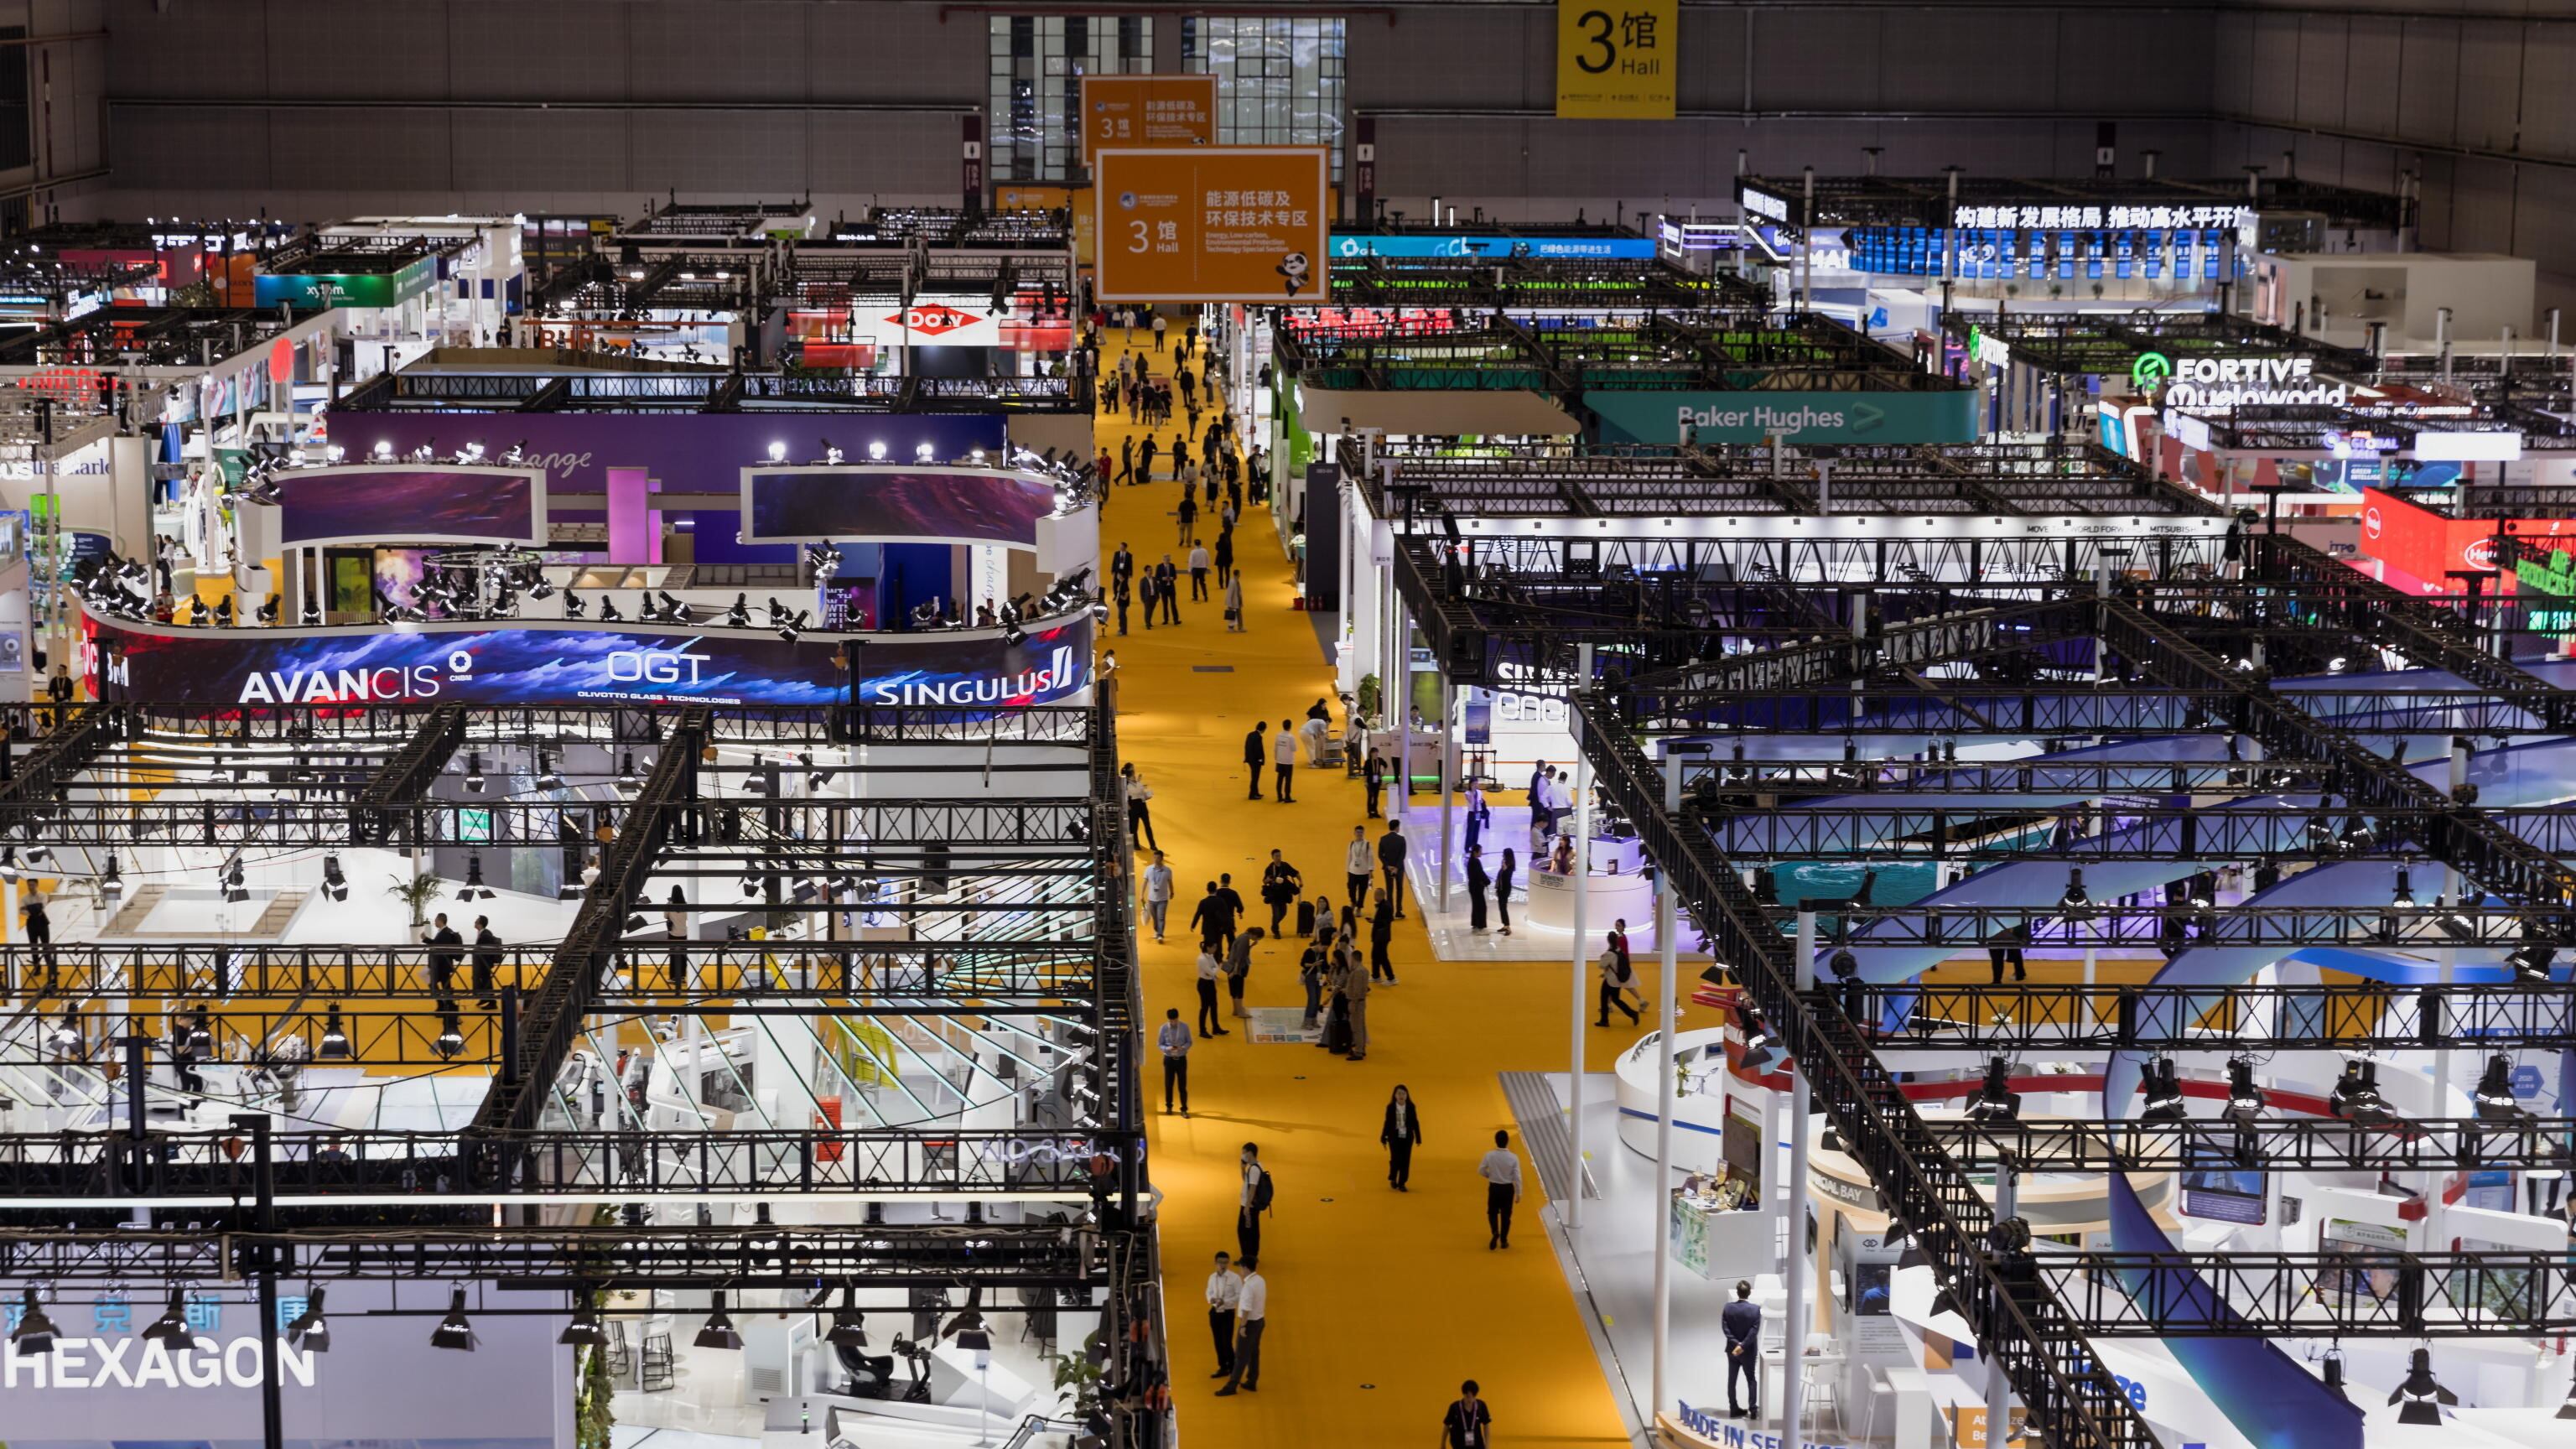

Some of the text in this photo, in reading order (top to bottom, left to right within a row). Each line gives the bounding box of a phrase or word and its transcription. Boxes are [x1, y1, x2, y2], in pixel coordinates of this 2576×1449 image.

[1621, 11, 1658, 49] 馆
[1576, 10, 1617, 75] 3
[1622, 59, 1660, 75] Hall
[1100, 117, 1114, 138] 3
[1206, 190, 1291, 207] 能源低碳及
[1205, 210, 1308, 227] 环保技术专区
[1955, 206, 2101, 229] 构建新发展格局
[1128, 220, 1149, 253] 3
[1157, 221, 1177, 241] 馆
[1156, 242, 1179, 252] Hall
[1359, 247, 1379, 256] GL
[306, 284, 345, 299] xylm
[2176, 359, 2313, 383] FORTIVE
[1678, 405, 1845, 434] Baker Hughes
[2027, 525, 2049, 533] MOVE
[606, 651, 711, 685] OGT
[238, 665, 441, 704] AVANCIS
[875, 669, 1052, 706] SINGULUS
[577, 691, 628, 699] OLIVOTTO
[666, 695, 741, 705] TECHNOLOGIES
[1840, 1184, 1862, 1202] BAY
[4, 1337, 316, 1389] HEXAGON
[1678, 1399, 1720, 1441] TRADE
[1724, 1425, 1745, 1449] IN
